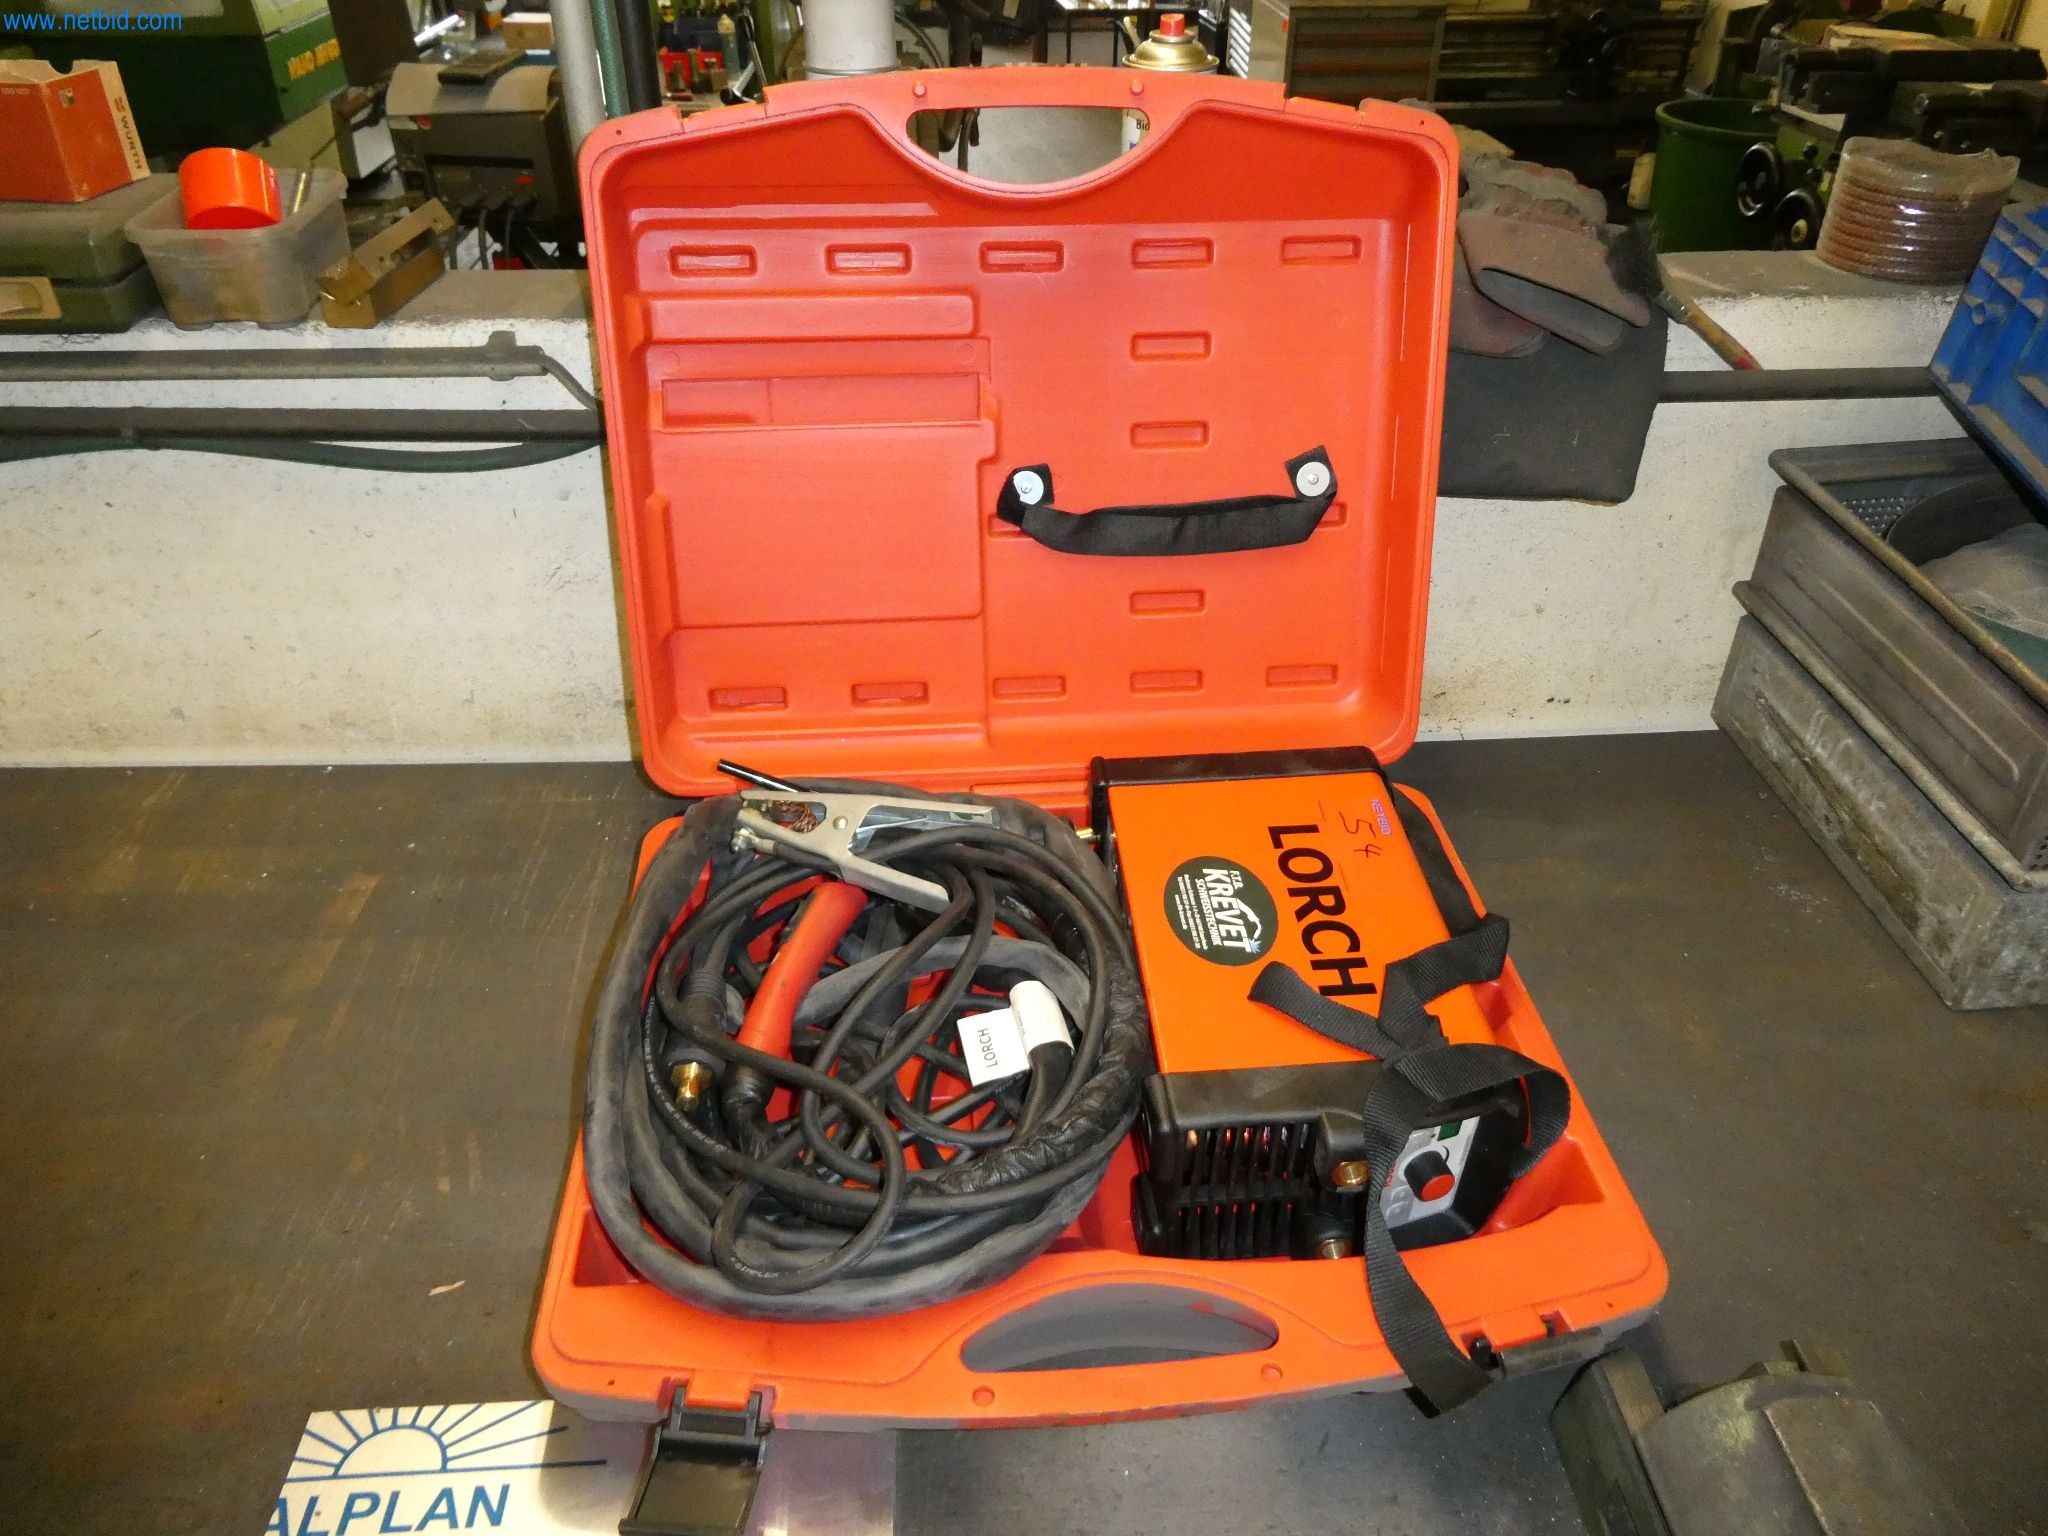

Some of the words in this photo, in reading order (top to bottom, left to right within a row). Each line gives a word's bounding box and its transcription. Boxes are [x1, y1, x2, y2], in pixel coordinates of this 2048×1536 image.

[1194, 878, 1222, 946] SCHWEISSTECHNIK
[1202, 868, 1252, 953] KREVET
[1229, 870, 1244, 890] F.T.B.
[1268, 824, 1378, 997] LORCH
[977, 1028, 998, 1068] LORCH
